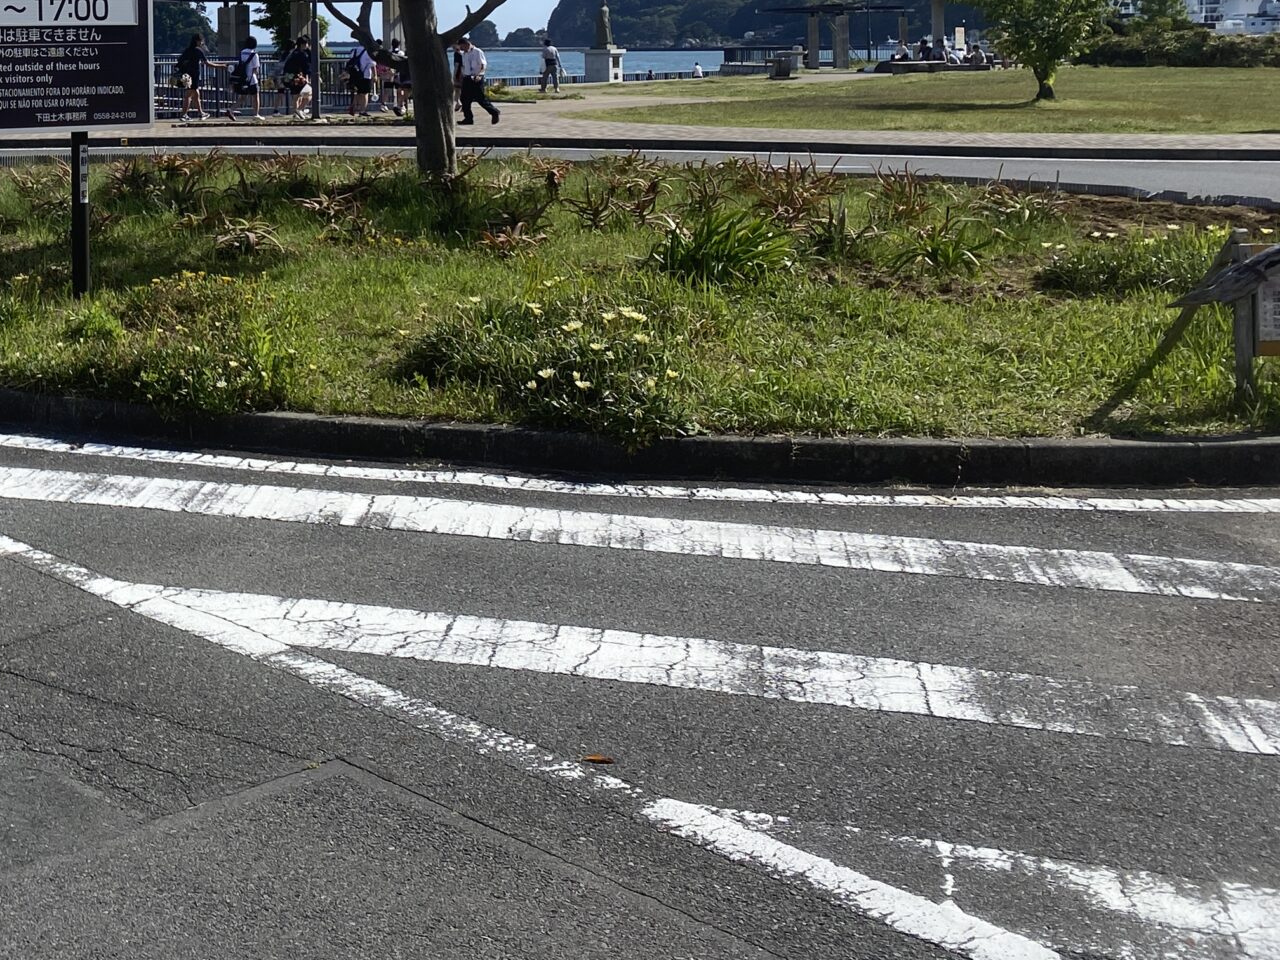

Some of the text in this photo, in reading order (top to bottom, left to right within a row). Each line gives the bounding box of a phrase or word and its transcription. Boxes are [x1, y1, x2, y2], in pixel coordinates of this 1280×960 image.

[14, 62, 43, 71] outside
[45, 61, 54, 70] of
[55, 61, 76, 70] these
[78, 61, 100, 70] hours
[4, 73, 34, 83] visitors
[35, 73, 53, 84] only
[45, 87, 60, 96] FORA
[61, 86, 70, 95] DO
[9, 99, 16, 108] SE
[17, 98, 30, 108] NÃO
[31, 98, 43, 107] FOR
[43, 98, 58, 107] USAR
[59, 98, 64, 107] O
